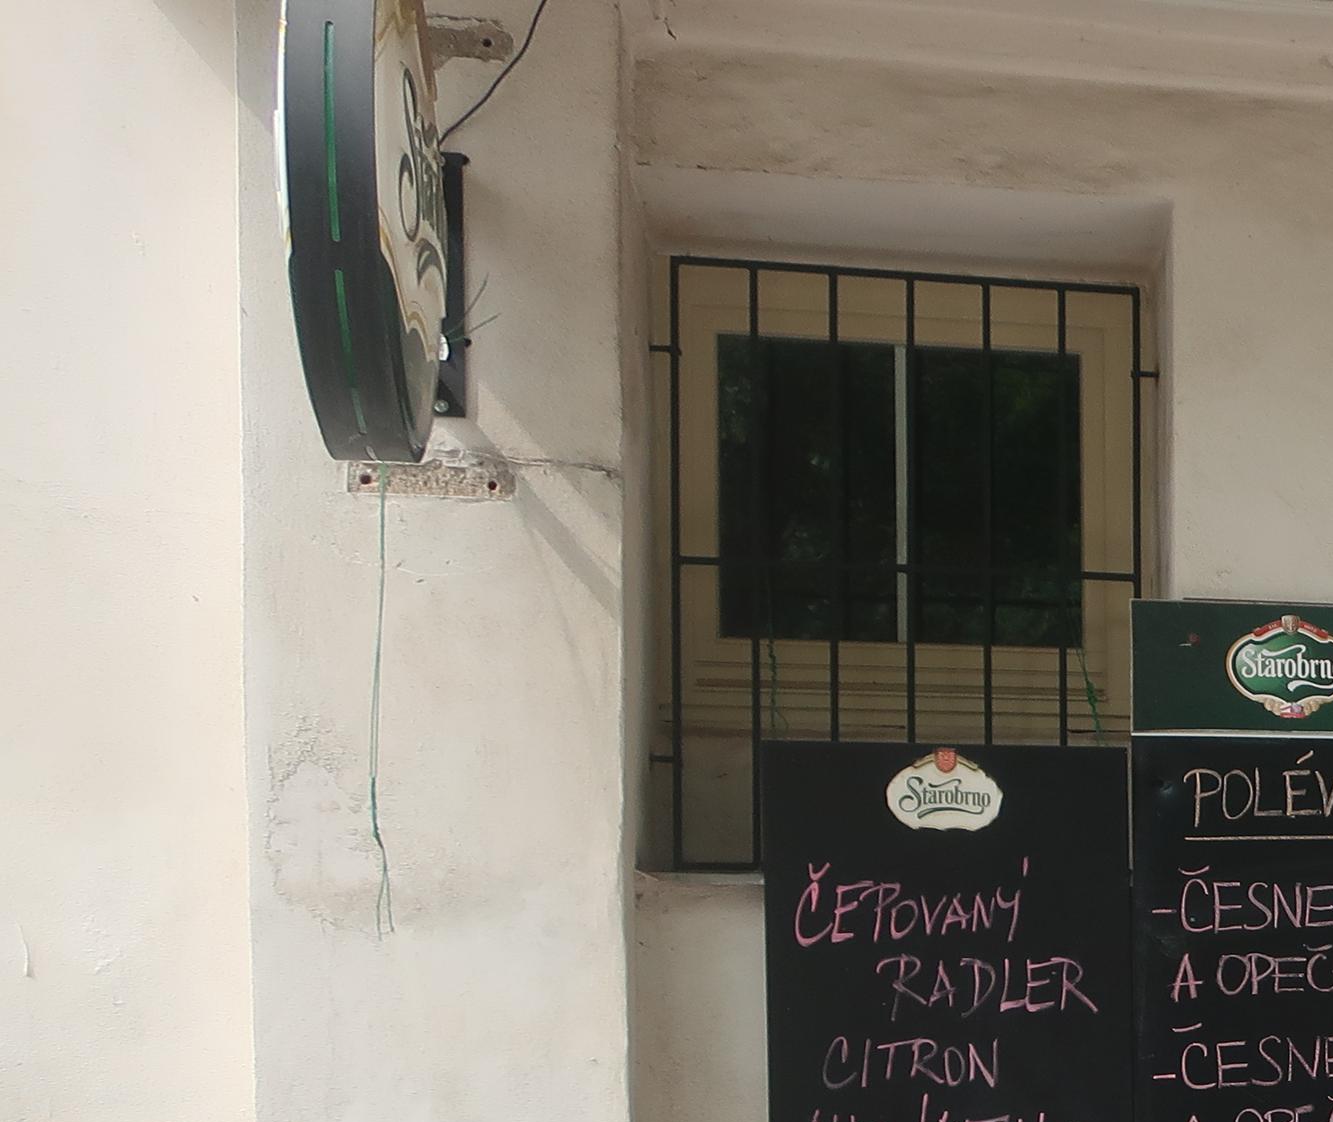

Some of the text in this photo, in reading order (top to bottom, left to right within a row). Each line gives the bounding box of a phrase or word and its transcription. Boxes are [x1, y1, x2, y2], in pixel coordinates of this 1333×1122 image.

[899, 776, 991, 819] Starobrno
[876, 953, 1099, 1021] RADLER
[1169, 953, 1203, 1002] A
[822, 1036, 1000, 1088] CITRON
